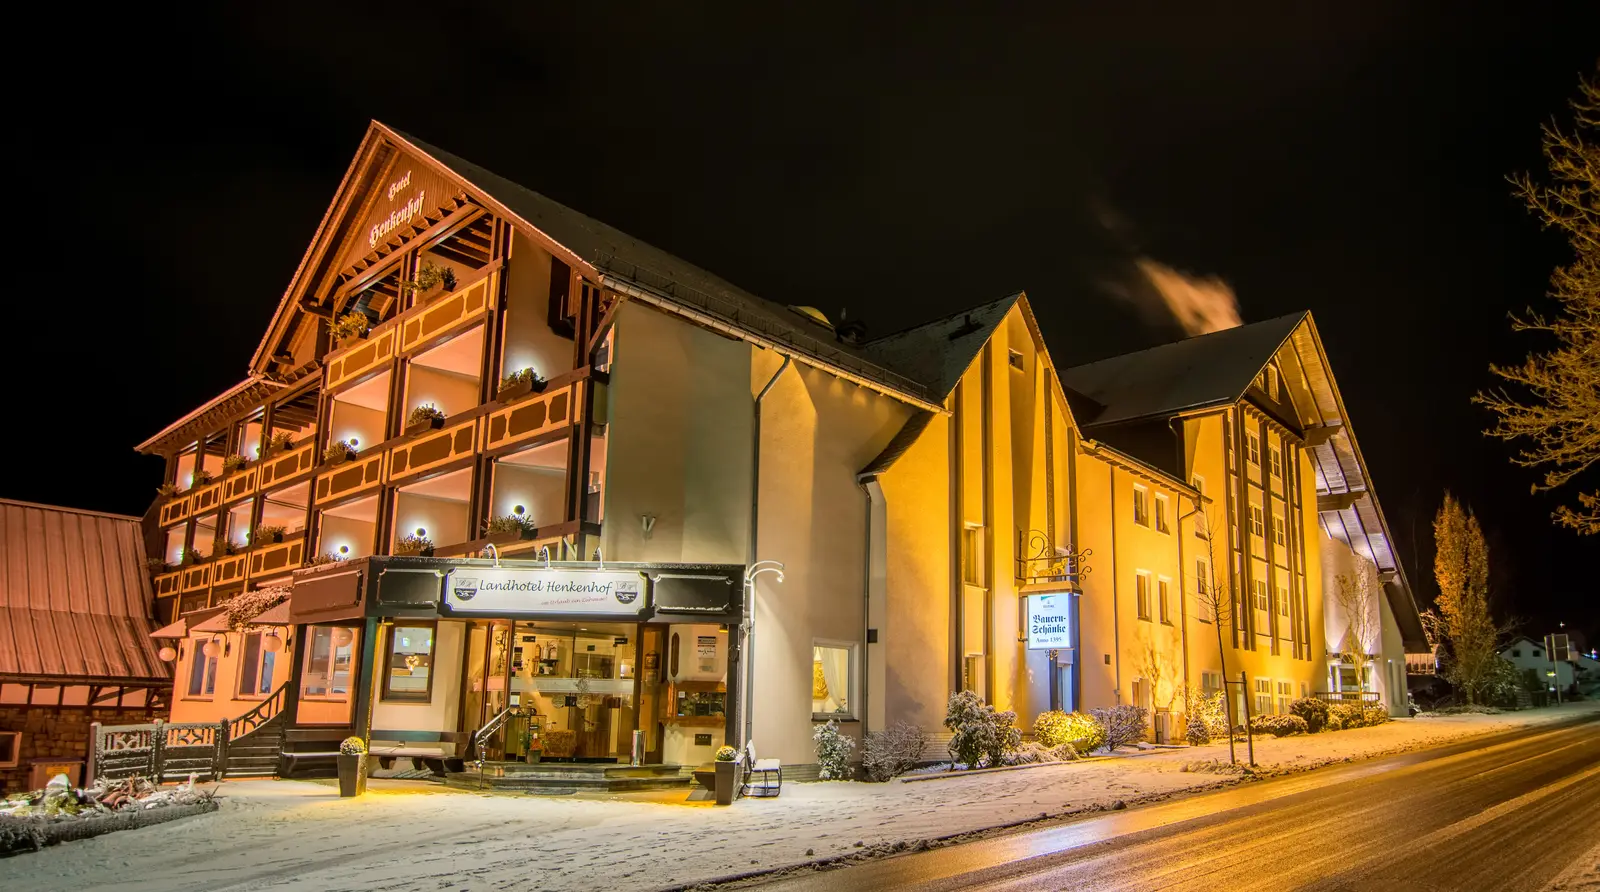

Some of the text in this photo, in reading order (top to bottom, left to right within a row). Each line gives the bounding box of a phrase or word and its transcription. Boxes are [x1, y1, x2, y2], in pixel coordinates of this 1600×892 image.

[388, 170, 411, 201] Hotel
[369, 190, 425, 248] Henkenhof
[479, 579, 544, 592] Landhotel
[546, 580, 613, 595] Henkenhof
[1032, 614, 1067, 624] Bauern-
[1032, 624, 1066, 635] Schänke
